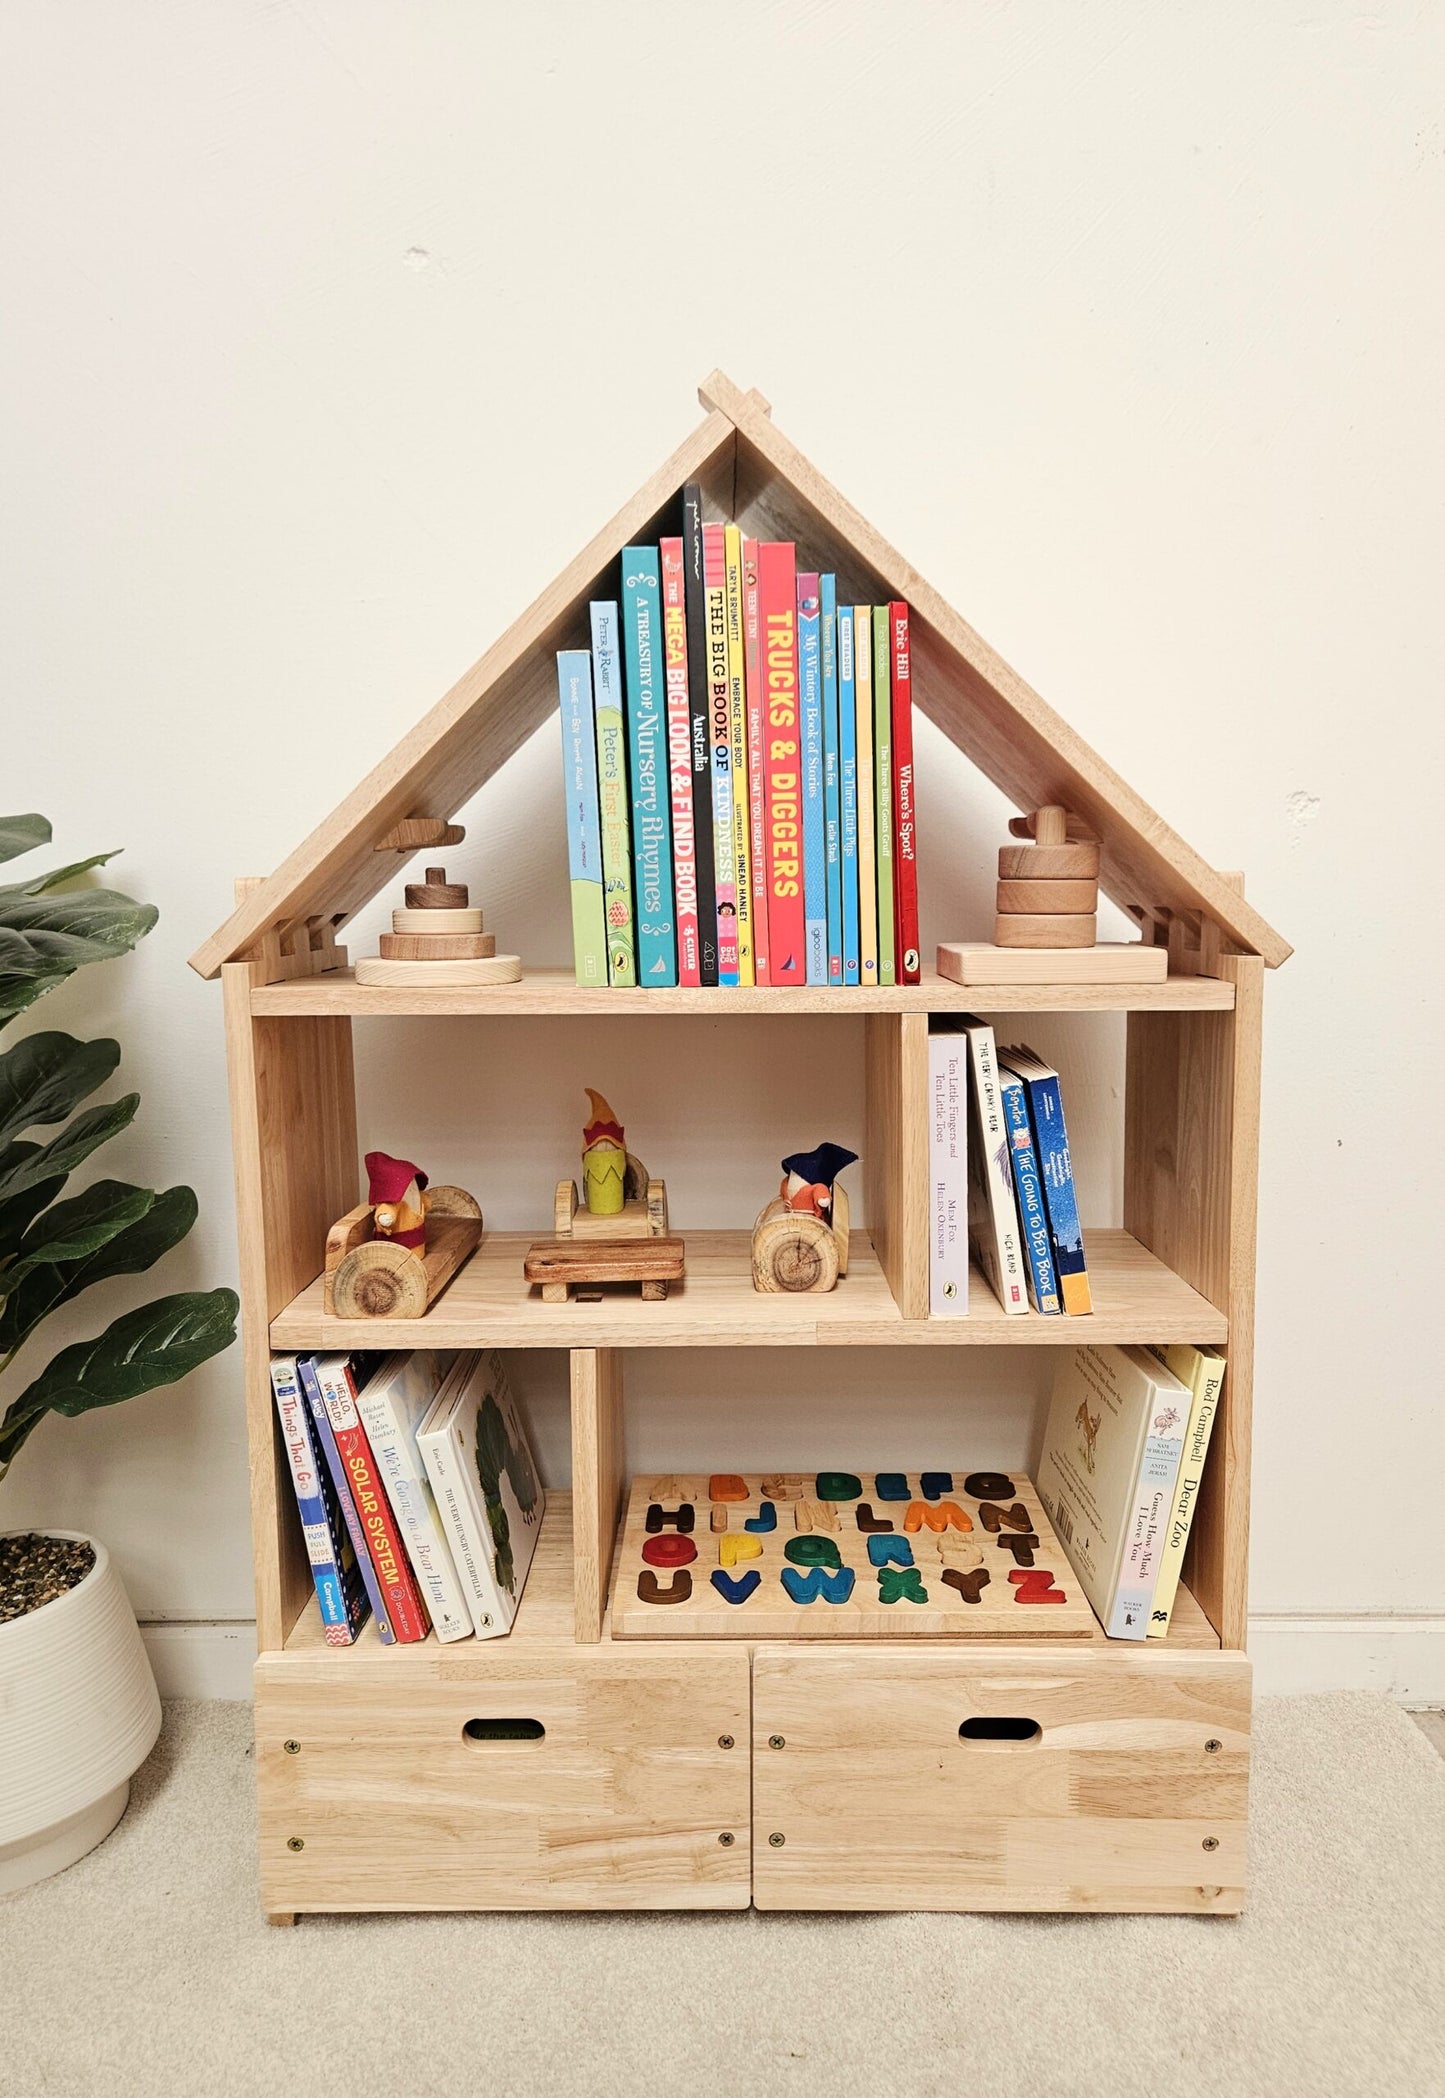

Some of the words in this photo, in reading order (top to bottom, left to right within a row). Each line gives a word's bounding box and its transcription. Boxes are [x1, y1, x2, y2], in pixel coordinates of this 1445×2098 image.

[668, 581, 678, 603] THE
[729, 565, 737, 593] TARYN
[636, 596, 649, 608] A
[710, 591, 724, 635] THE
[730, 596, 739, 641] BRUMFITT
[666, 606, 685, 665] MEGA
[896, 619, 908, 650] Eric
[637, 612, 652, 687] TREASURY
[712, 642, 725, 677] BIG
[767, 610, 795, 727] TRUCKS
[897, 653, 909, 680] Hill
[640, 691, 653, 709] OF
[667, 668, 687, 705] BIG
[732, 677, 741, 718] EMBRACE
[713, 683, 728, 740] BOOK
[807, 708, 818, 738] Book
[668, 711, 691, 769] LOOK
[693, 713, 708, 772] Australia
[733, 721, 742, 744] YOUR
[603, 728, 618, 777] Peter's
[634, 711, 659, 811] Nursery
[716, 745, 729, 771] OF
[734, 749, 743, 768] BODY
[751, 750, 760, 769] ALL
[770, 740, 796, 760] &
[807, 740, 818, 755] of
[827, 753, 835, 772] Mem
[845, 757, 855, 776] The
[671, 773, 691, 793] &
[752, 772, 761, 798] THAT
[808, 758, 820, 799] Stories
[827, 773, 836, 786] Fox
[899, 764, 912, 820] Where's
[845, 780, 855, 807] Three
[752, 800, 761, 820] YOU
[845, 809, 856, 835] Little
[881, 809, 889, 832] Goats
[672, 796, 694, 857] FIND
[716, 775, 733, 882] KINDNESS
[753, 823, 763, 856] DREAM
[771, 773, 799, 897] DIGGERS
[844, 838, 856, 857] Pigs
[881, 835, 890, 857] Gruff
[899, 822, 914, 861] Spot?
[635, 816, 665, 913] Rhymes
[738, 854, 746, 885] SINEAD
[754, 858, 763, 869] IT
[754, 871, 763, 883] TO
[675, 861, 697, 916] BOOK
[755, 886, 763, 897] BE
[739, 889, 748, 922] HANLEY
[685, 937, 696, 970] CLEVER
[979, 1043, 988, 1057] THE
[949, 1057, 958, 1074] Ten
[981, 1059, 991, 1080] VERY
[936, 1073, 944, 1090] Ten
[949, 1078, 959, 1103] Little
[936, 1094, 946, 1119] Little
[936, 1122, 945, 1143] Toes
[947, 1106, 959, 1141] Fingers
[989, 1114, 998, 1133] BEAR
[1018, 1149, 1033, 1172] THE
[1021, 1173, 1039, 1211] GOING
[949, 1225, 957, 1242] FOX
[1030, 1213, 1042, 1228] TO
[1004, 1234, 1014, 1251] NICK
[1031, 1228, 1047, 1256] BED
[1037, 1257, 1052, 1294] BOOK
[335, 1383, 350, 1415] HELLO,
[1203, 1379, 1219, 1402] Rod
[282, 1397, 298, 1438] Things
[1190, 1406, 1213, 1462] Campbell
[290, 1437, 305, 1468] That
[297, 1472, 312, 1490] Go
[1150, 1492, 1163, 1521] Guess
[1177, 1479, 1198, 1517] Dear
[349, 1457, 379, 1515] SOLAR
[367, 1516, 400, 1585] SYSTEM
[382, 1446, 401, 1477] We're
[394, 1480, 412, 1516] Going
[416, 1545, 433, 1572] Bear
[427, 1574, 446, 1603] Hunt
[1136, 1514, 1148, 1539] Love
[1170, 1521, 1188, 1548] Zoo
[308, 1532, 325, 1540] PUSH
[445, 1488, 455, 1504] THE
[450, 1503, 460, 1523] VERY
[455, 1523, 469, 1553] HUNGRY
[464, 1553, 483, 1599] CATERPILLAR
[1146, 1524, 1157, 1548] How
[1130, 1542, 1142, 1561] You
[1139, 1550, 1152, 1578] Much
[637, 1569, 692, 1604] U
[710, 1570, 761, 1604] V
[780, 1567, 856, 1604] W
[876, 1568, 929, 1604] X
[941, 1568, 991, 1604] Y
[1007, 1569, 1067, 1604] Z
[323, 1581, 339, 1621] Campbell
